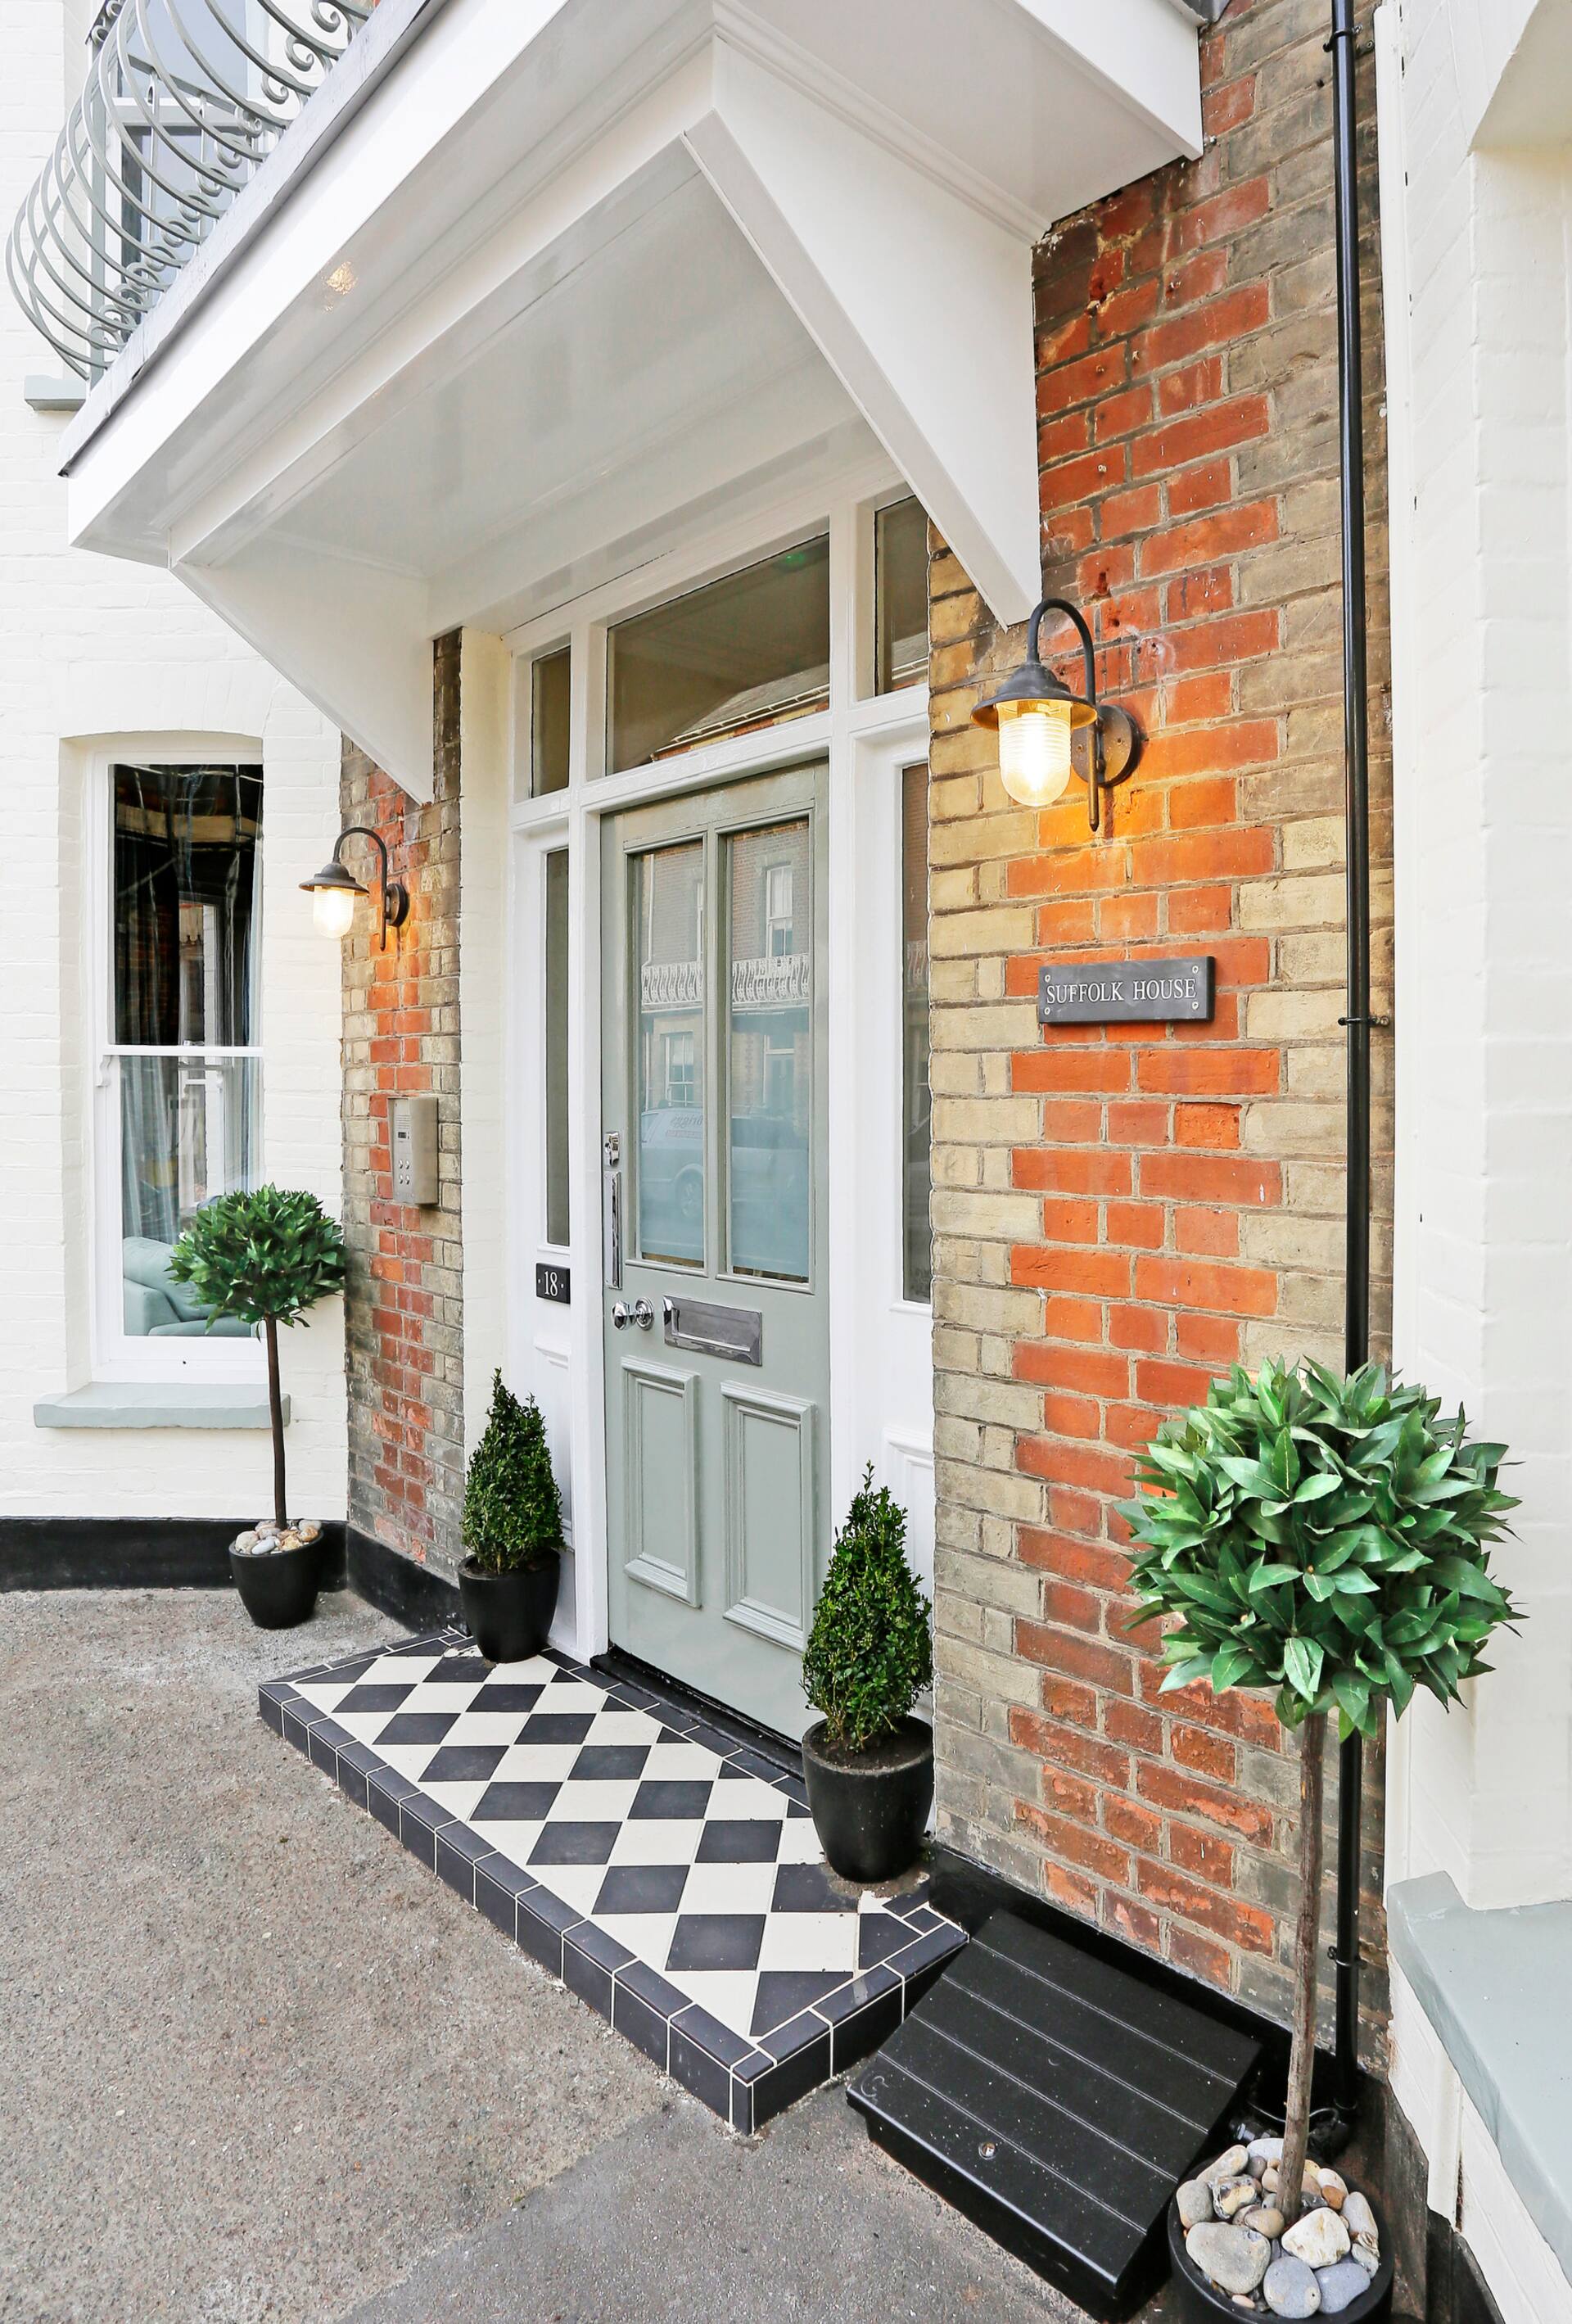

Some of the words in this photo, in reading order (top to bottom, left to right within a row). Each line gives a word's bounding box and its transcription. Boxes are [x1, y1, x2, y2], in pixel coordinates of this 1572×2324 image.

[1046, 982, 1124, 1004] SUFFOLK
[1133, 979, 1196, 1000] HOUSE
[544, 1271, 558, 1296] 18
